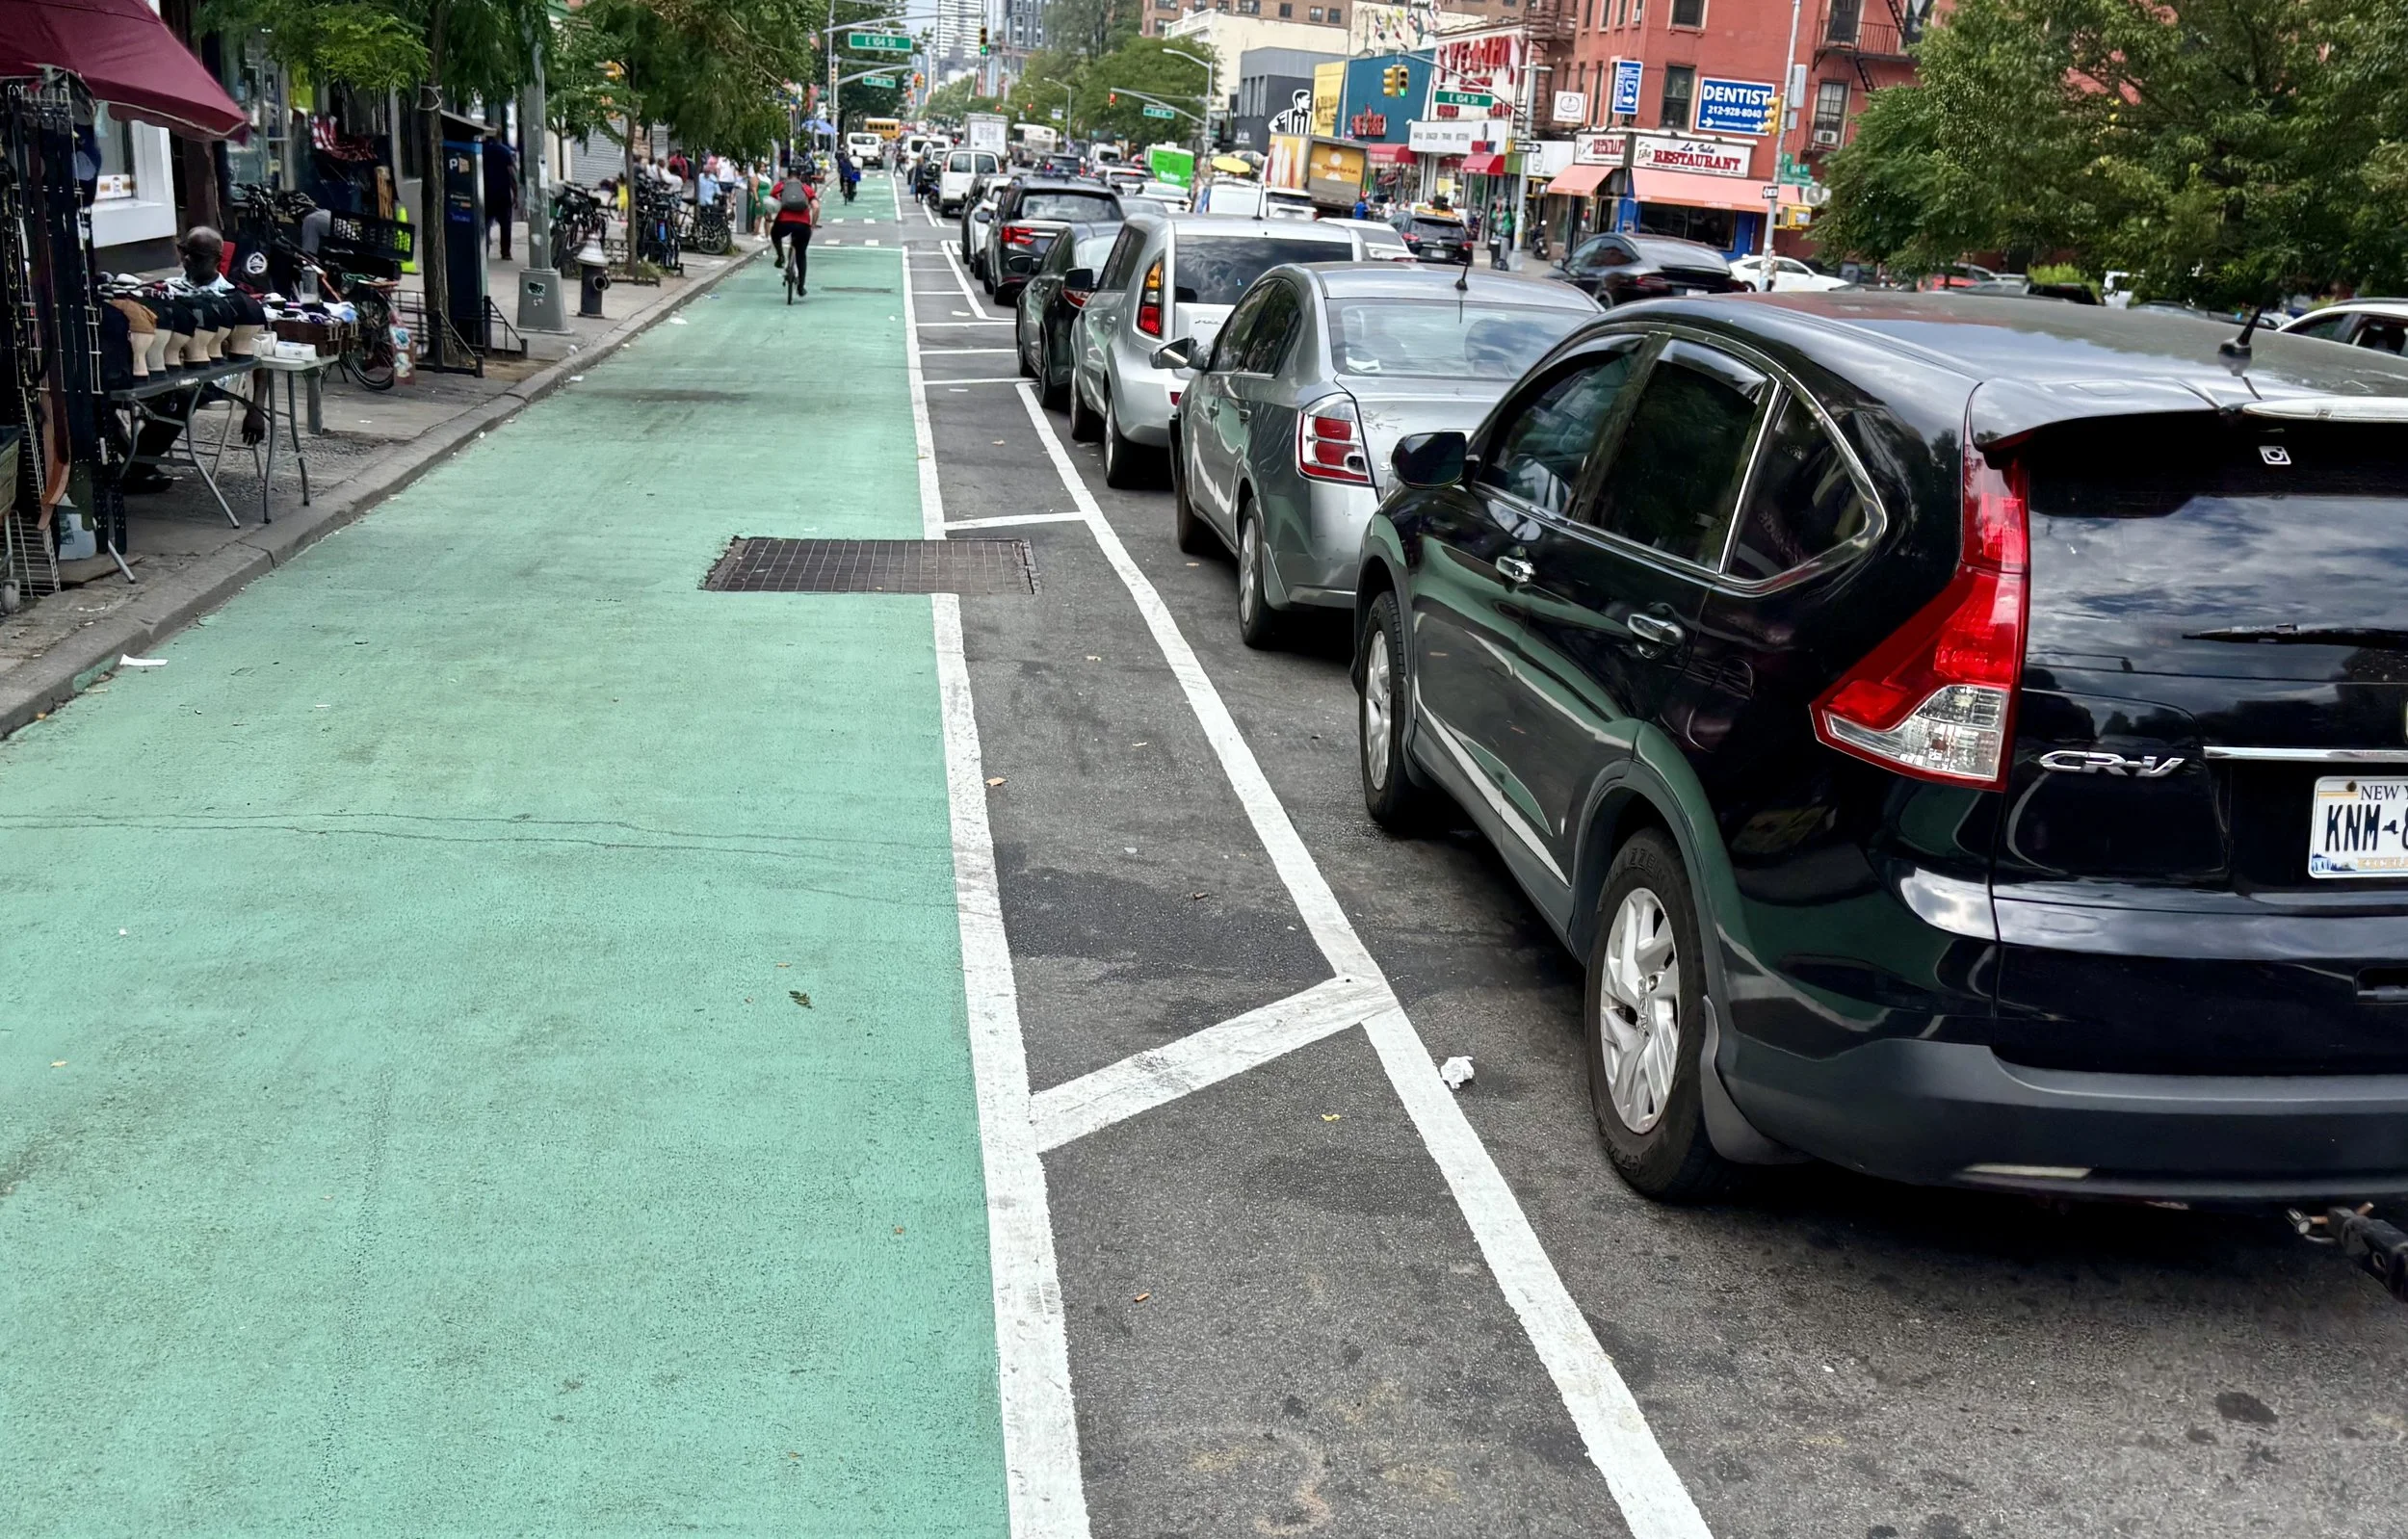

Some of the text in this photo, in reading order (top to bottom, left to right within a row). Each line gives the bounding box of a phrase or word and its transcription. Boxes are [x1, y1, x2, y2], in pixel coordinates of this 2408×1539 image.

[1449, 93, 1454, 102] E
[1456, 94, 1469, 103] 104
[1703, 85, 1770, 106] DENTIST
[1653, 149, 1741, 170] RESTAURANT
[2039, 750, 2185, 777] CR-V
[2361, 785, 2399, 800] NEW
